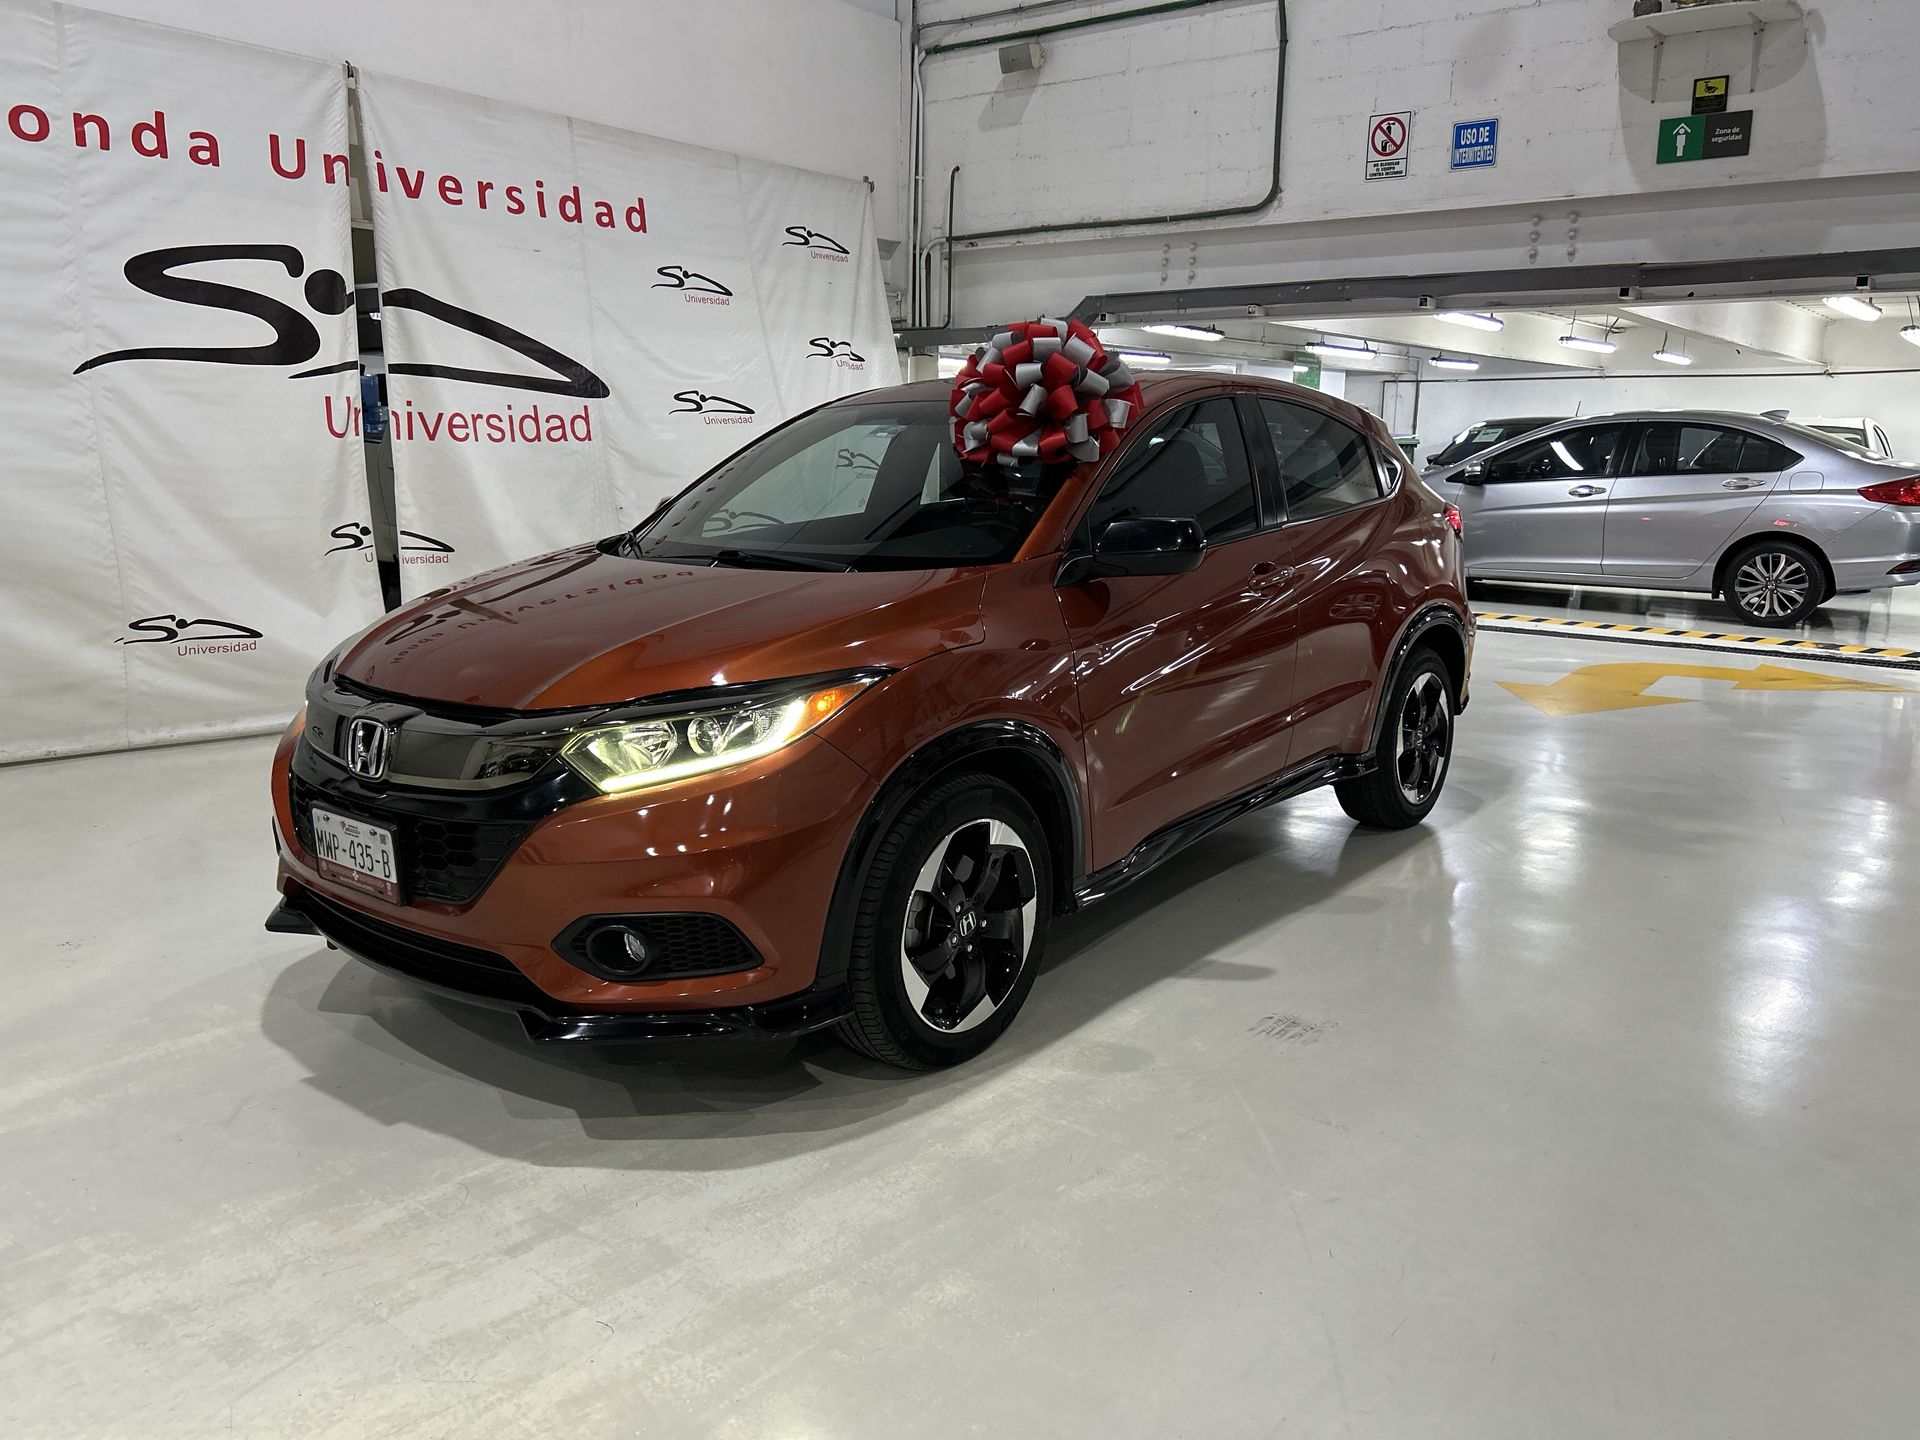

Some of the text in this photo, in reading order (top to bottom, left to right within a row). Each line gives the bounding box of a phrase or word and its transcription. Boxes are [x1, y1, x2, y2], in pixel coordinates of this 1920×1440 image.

[1460, 126, 1490, 146] USO DE
[1711, 133, 1743, 143] seguridad
[810, 251, 849, 263] Universidad
[684, 293, 730, 305] Universidad
[704, 415, 753, 425] Universidad
[364, 552, 449, 564] Uiversidad
[177, 640, 257, 657] Universidad
[315, 827, 391, 879] MWP-435-B
